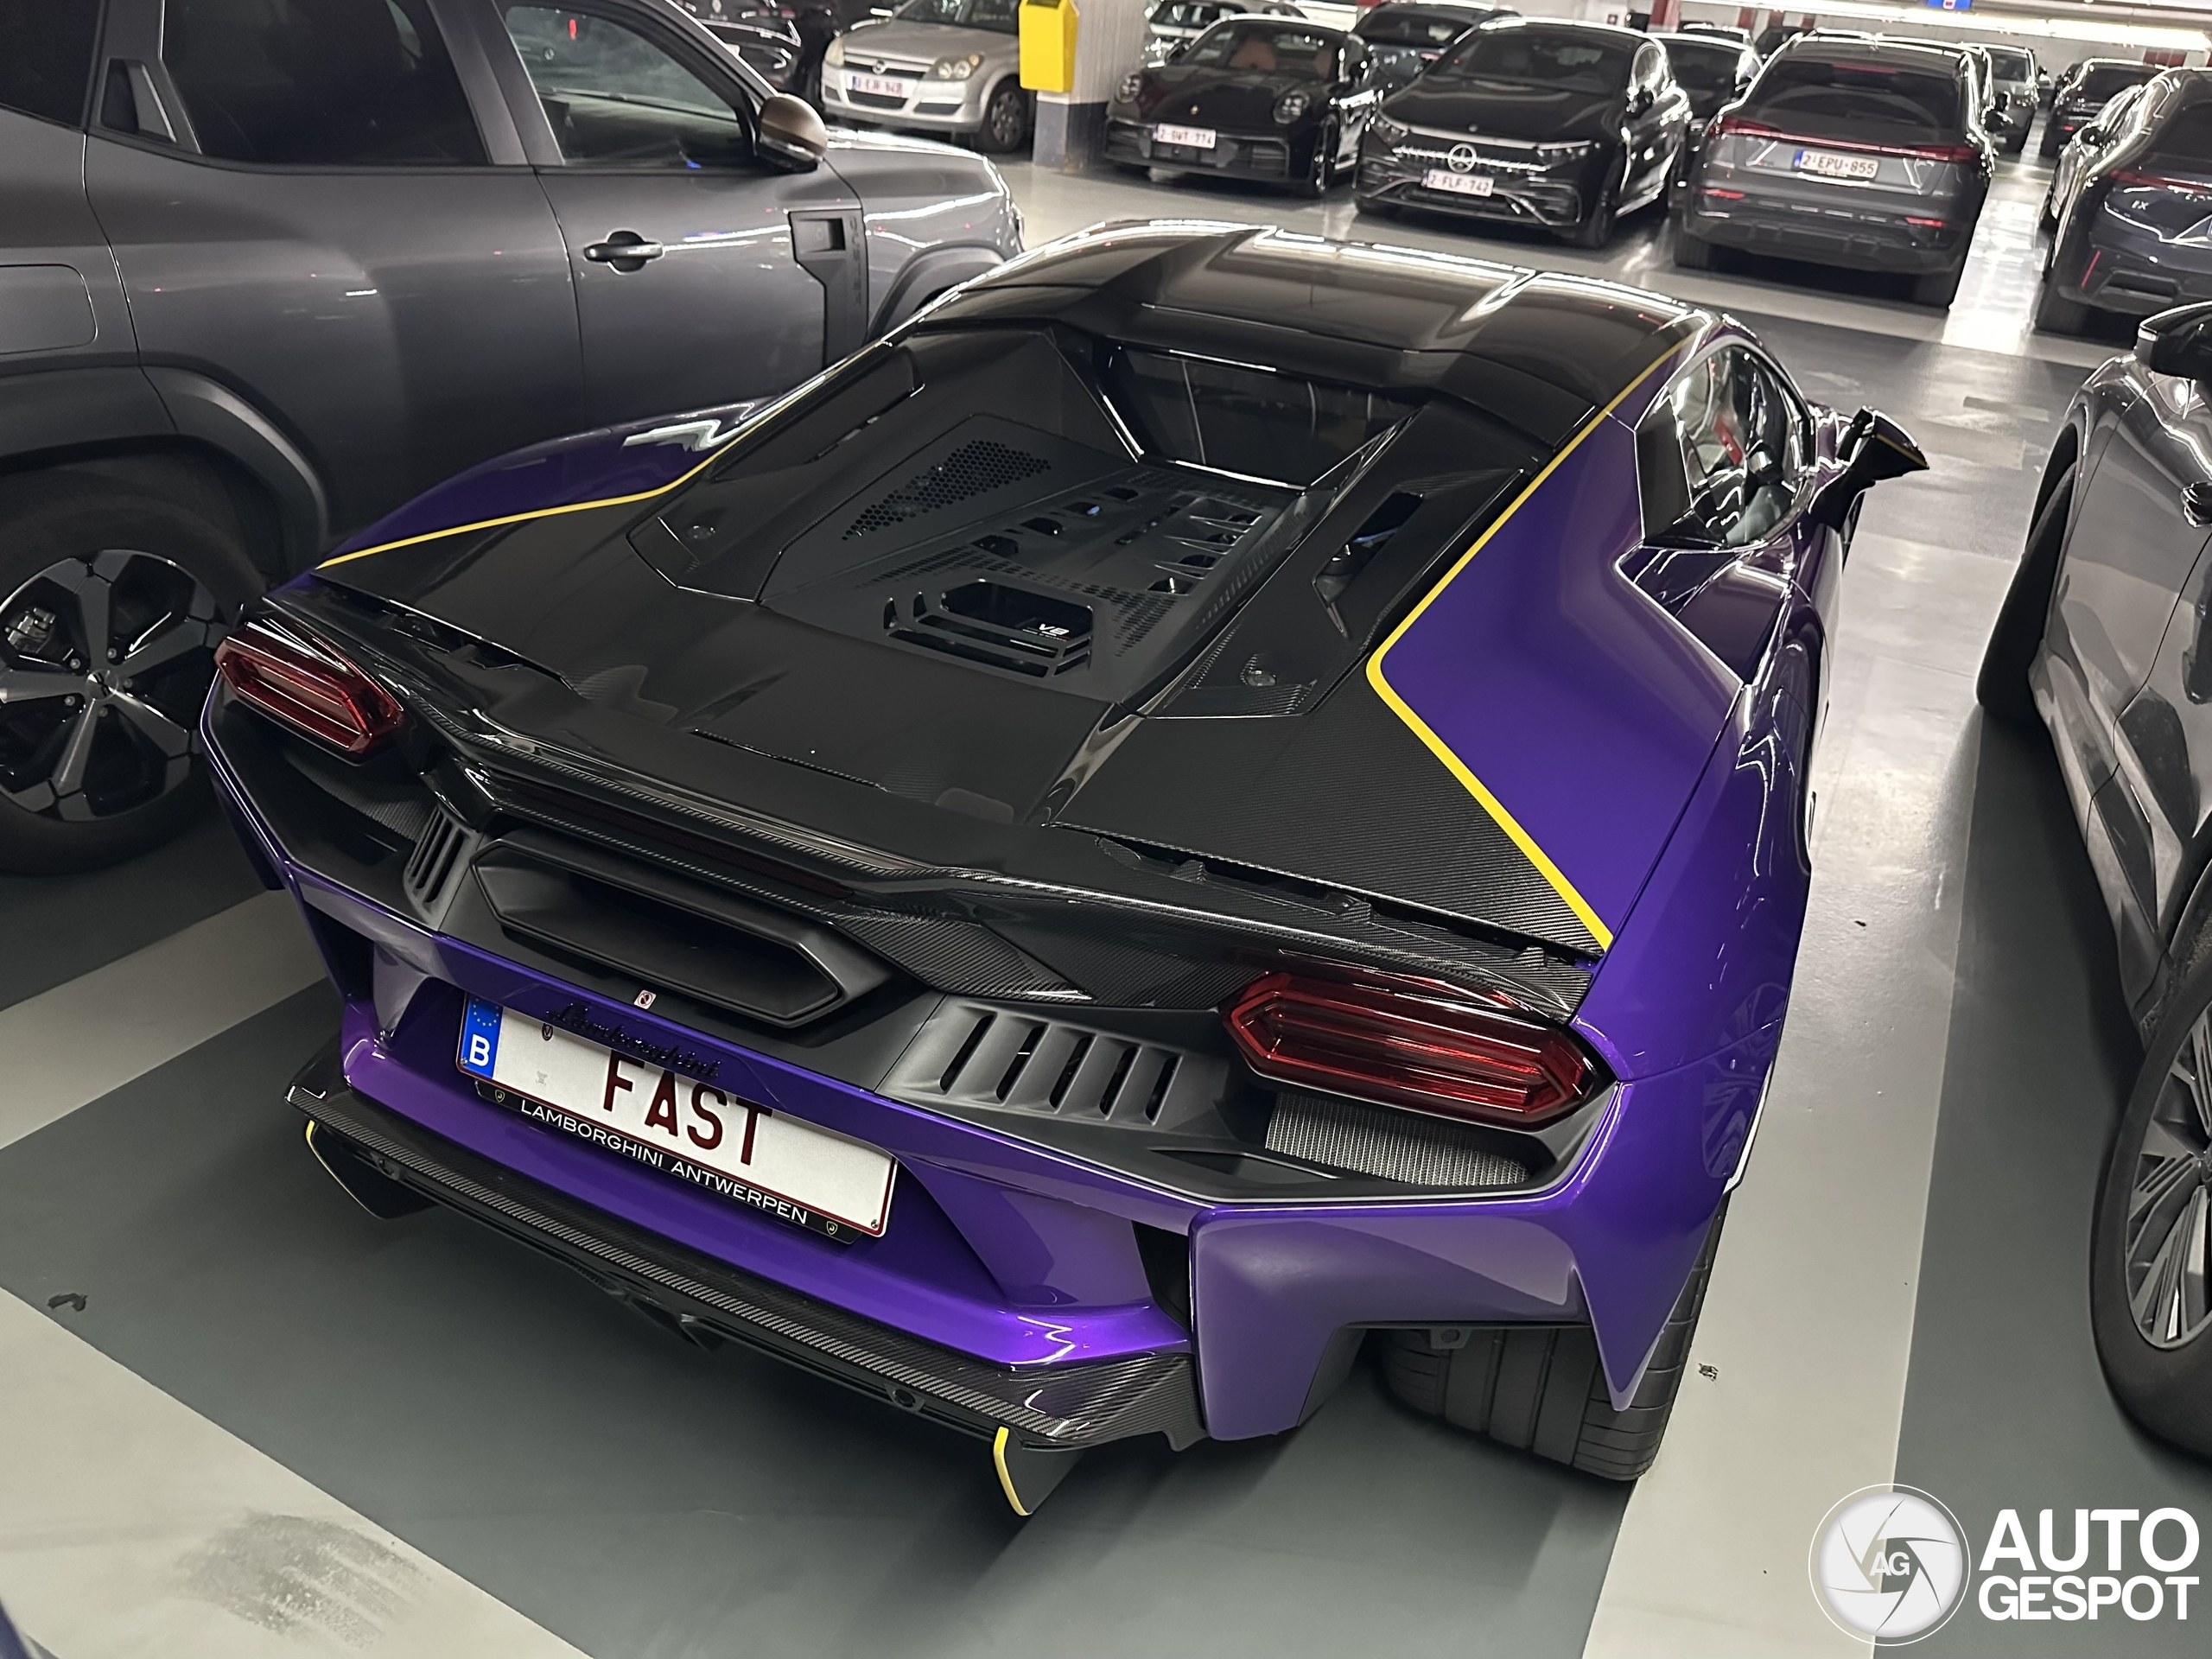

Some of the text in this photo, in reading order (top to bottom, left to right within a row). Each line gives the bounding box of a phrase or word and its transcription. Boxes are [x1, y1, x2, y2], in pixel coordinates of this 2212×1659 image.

[468, 1033, 491, 1067] B
[545, 1002, 722, 1078] Lamborghini
[602, 1048, 773, 1166] FAST
[520, 1099, 808, 1225] LAMBORGHINI ANTWERPEN
